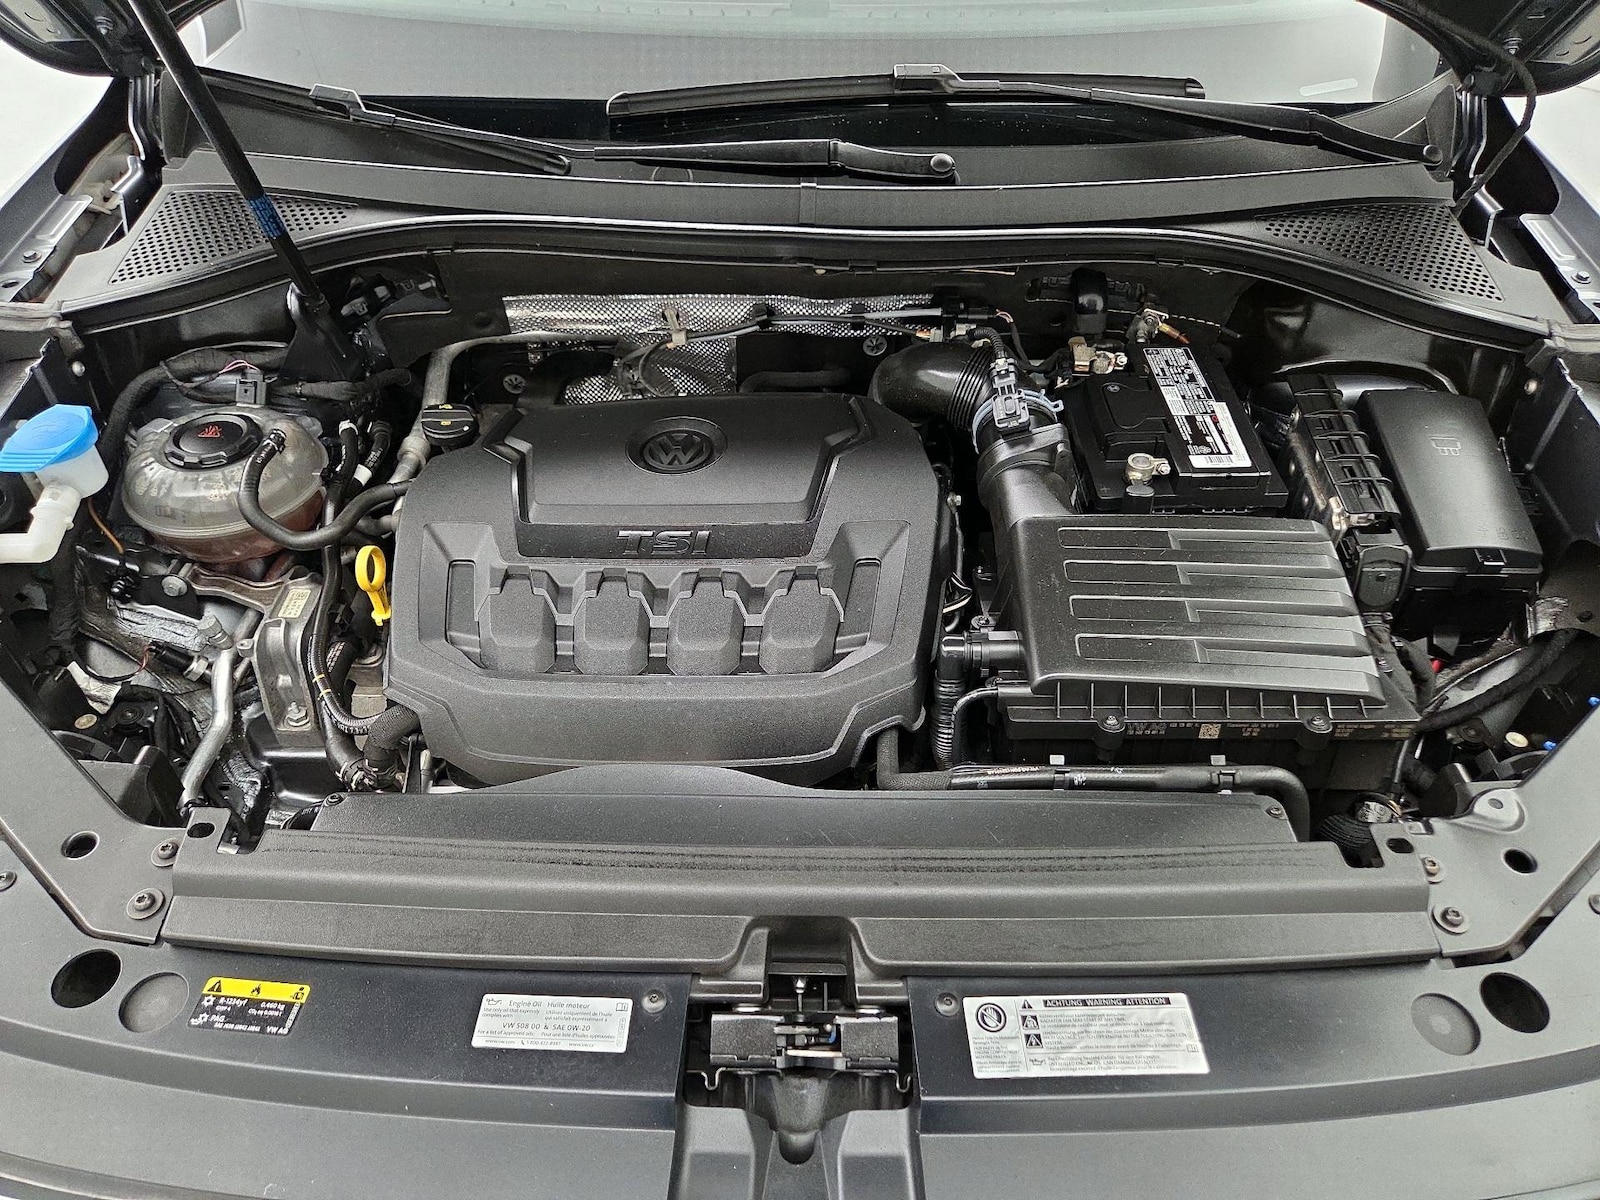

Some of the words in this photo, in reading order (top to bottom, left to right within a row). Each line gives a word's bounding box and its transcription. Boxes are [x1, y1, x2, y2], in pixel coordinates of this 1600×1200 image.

[616, 530, 712, 555] TSI
[219, 997, 248, 1007] R-1234yf
[509, 1000, 531, 1008] Engine
[1085, 998, 1122, 1006] WARNING
[1126, 997, 1166, 1005] ATTENTION
[210, 1014, 226, 1022] PAG
[266, 1026, 278, 1034] VW
[278, 1027, 290, 1035] AG
[566, 1024, 590, 1032] 0W-20
